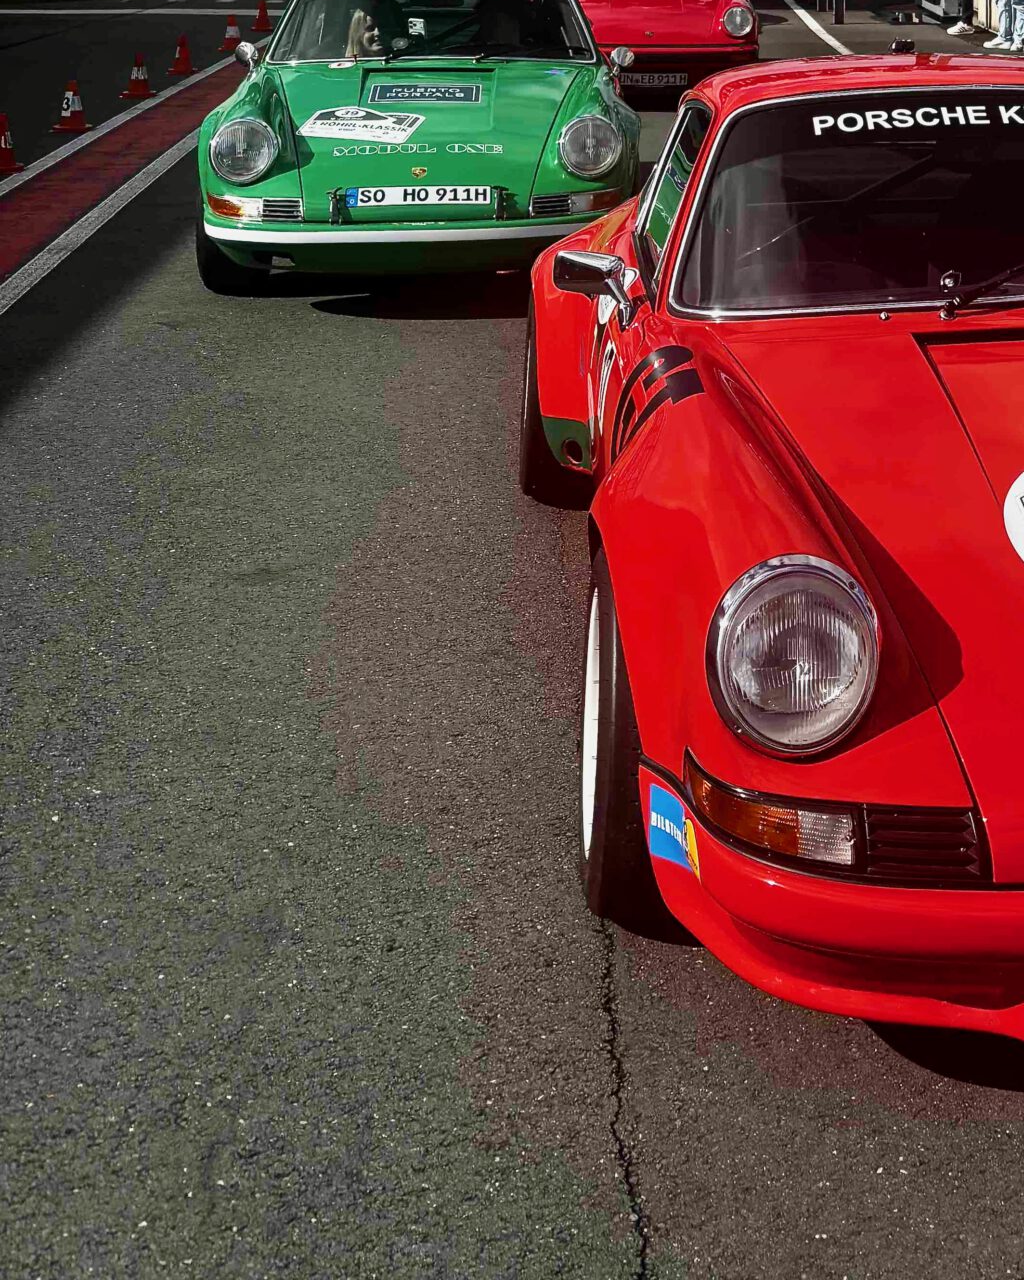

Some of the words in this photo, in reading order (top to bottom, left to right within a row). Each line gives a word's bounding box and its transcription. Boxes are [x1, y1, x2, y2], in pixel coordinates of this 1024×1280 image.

[341, 108, 359, 116] 39
[812, 105, 990, 136] PORSCHE
[446, 143, 503, 154] ONE
[359, 189, 386, 204] SO
[402, 188, 429, 202] HO
[435, 187, 487, 202] 911H
